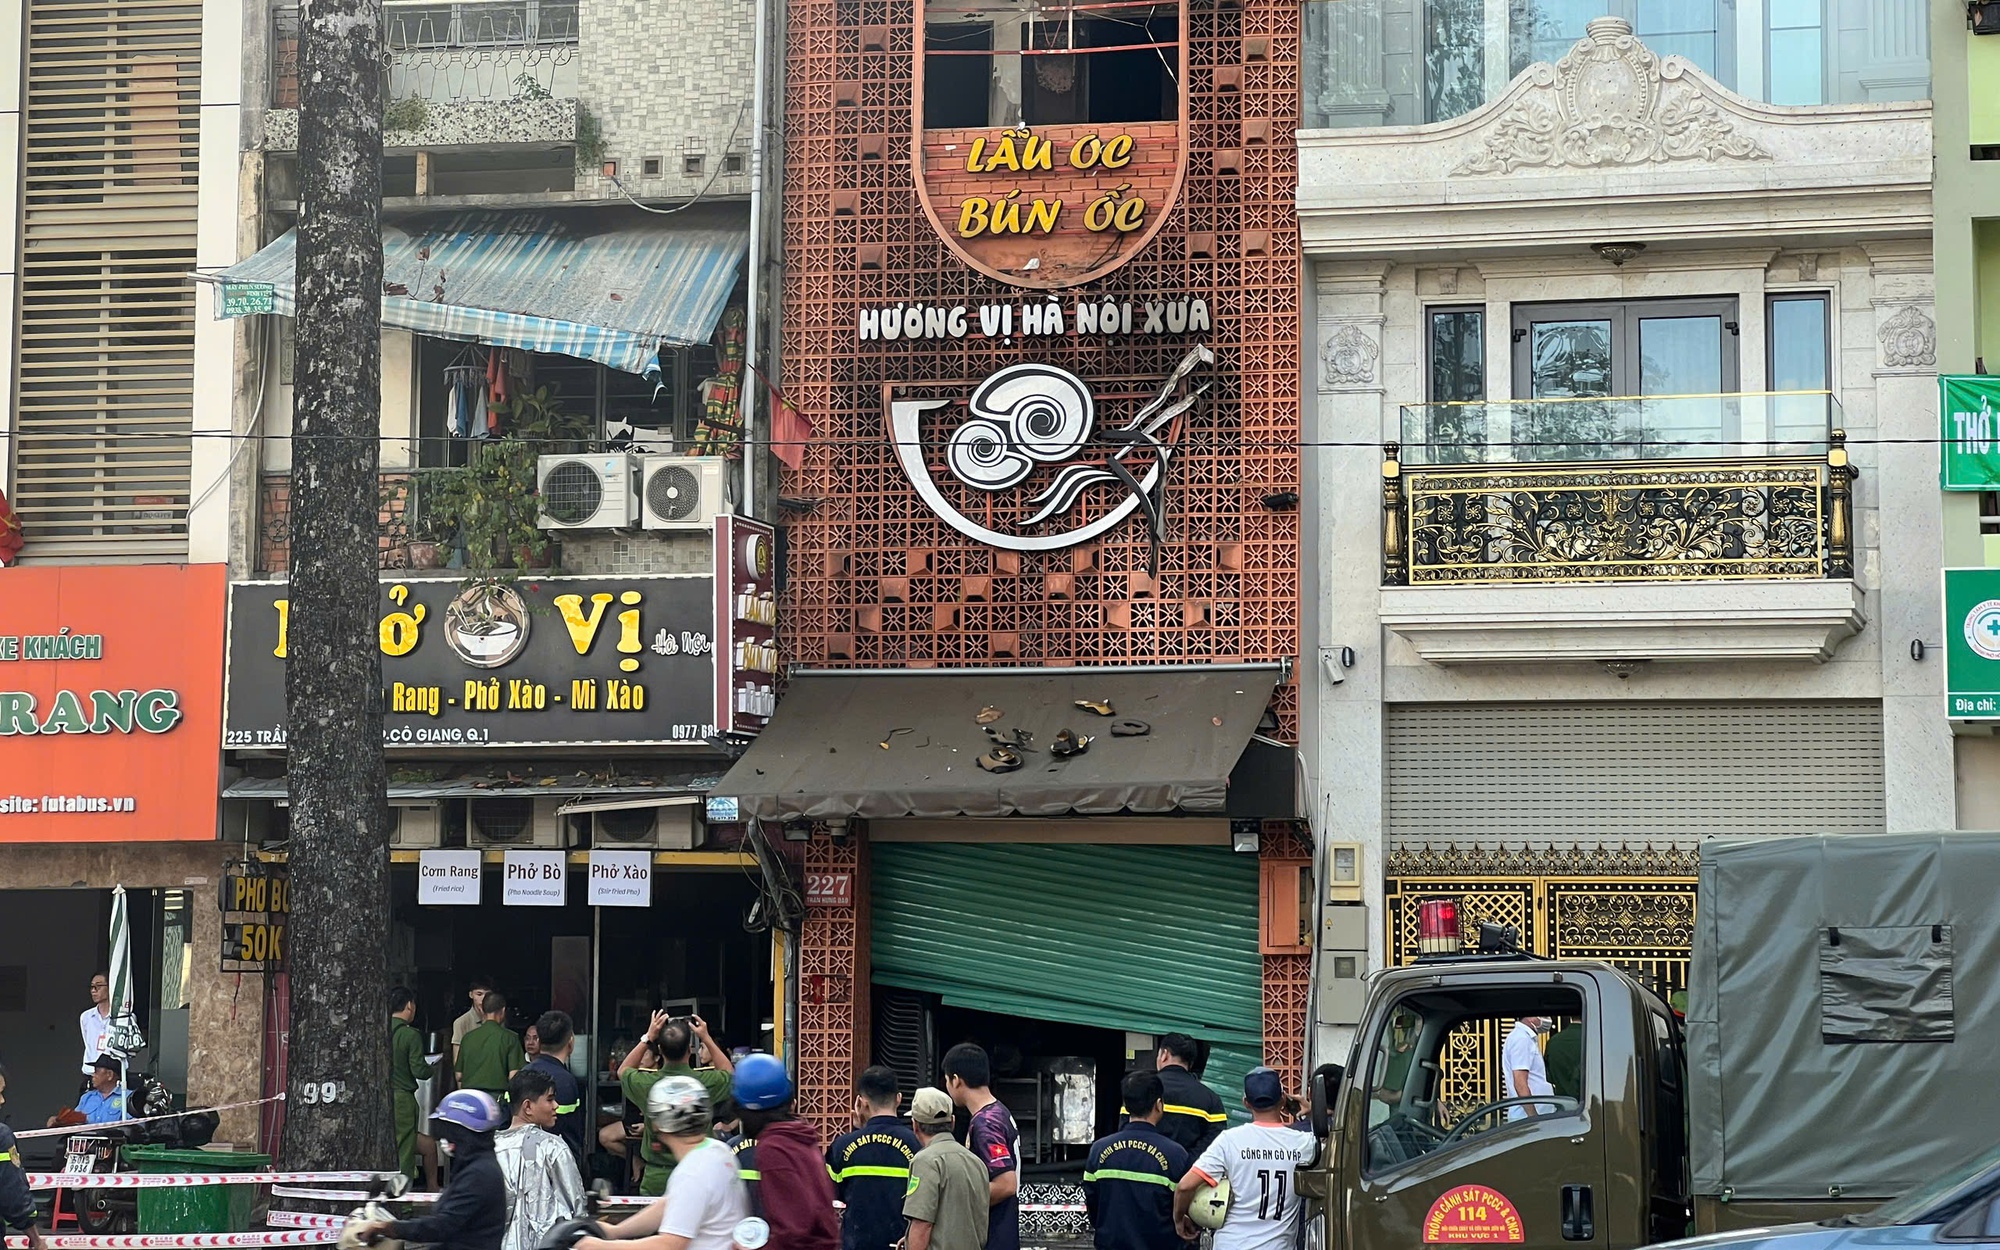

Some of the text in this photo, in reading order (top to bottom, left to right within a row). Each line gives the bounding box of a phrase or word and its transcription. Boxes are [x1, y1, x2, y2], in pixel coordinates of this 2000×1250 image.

[958, 183, 1147, 240] BÚN ỐC
[859, 294, 1210, 346] HƯƠNG VỊ HÀ NỘI XƯA
[1953, 394, 1992, 455] THỞ
[553, 590, 643, 673] Vị
[651, 628, 679, 656] Hà
[23, 627, 102, 660] KHÁCH
[393, 682, 440, 716] Rang
[464, 677, 500, 711] Phở
[508, 679, 546, 710] Xào
[571, 679, 596, 710] Mì
[606, 679, 644, 710] Xào
[1955, 698, 1975, 713] Địa
[0, 690, 182, 736] RANG
[227, 730, 252, 743] 225
[466, 728, 489, 742] Q.1
[672, 724, 698, 739] 0977
[41, 795, 135, 812] futabus.vn
[421, 865, 479, 879] Cơm Rang
[508, 862, 562, 880] Phở Bò
[592, 863, 648, 880] Phở Xào
[806, 875, 849, 895] 227
[241, 924, 283, 961] 50K
[872, 1133, 893, 1145] PCCC
[1127, 1139, 1148, 1151] PCCC
[1241, 1147, 1302, 1162] CÔNG AN GÒ VẤP
[1257, 1169, 1287, 1221] 11
[1427, 1210, 1445, 1240] PHÒNG
[1439, 1193, 1462, 1213] CẢNH
[1463, 1186, 1480, 1202] SÁT
[1481, 1192, 1504, 1211] PCCC
[1504, 1216, 1520, 1240] CNCH
[1458, 1206, 1487, 1221] 114
